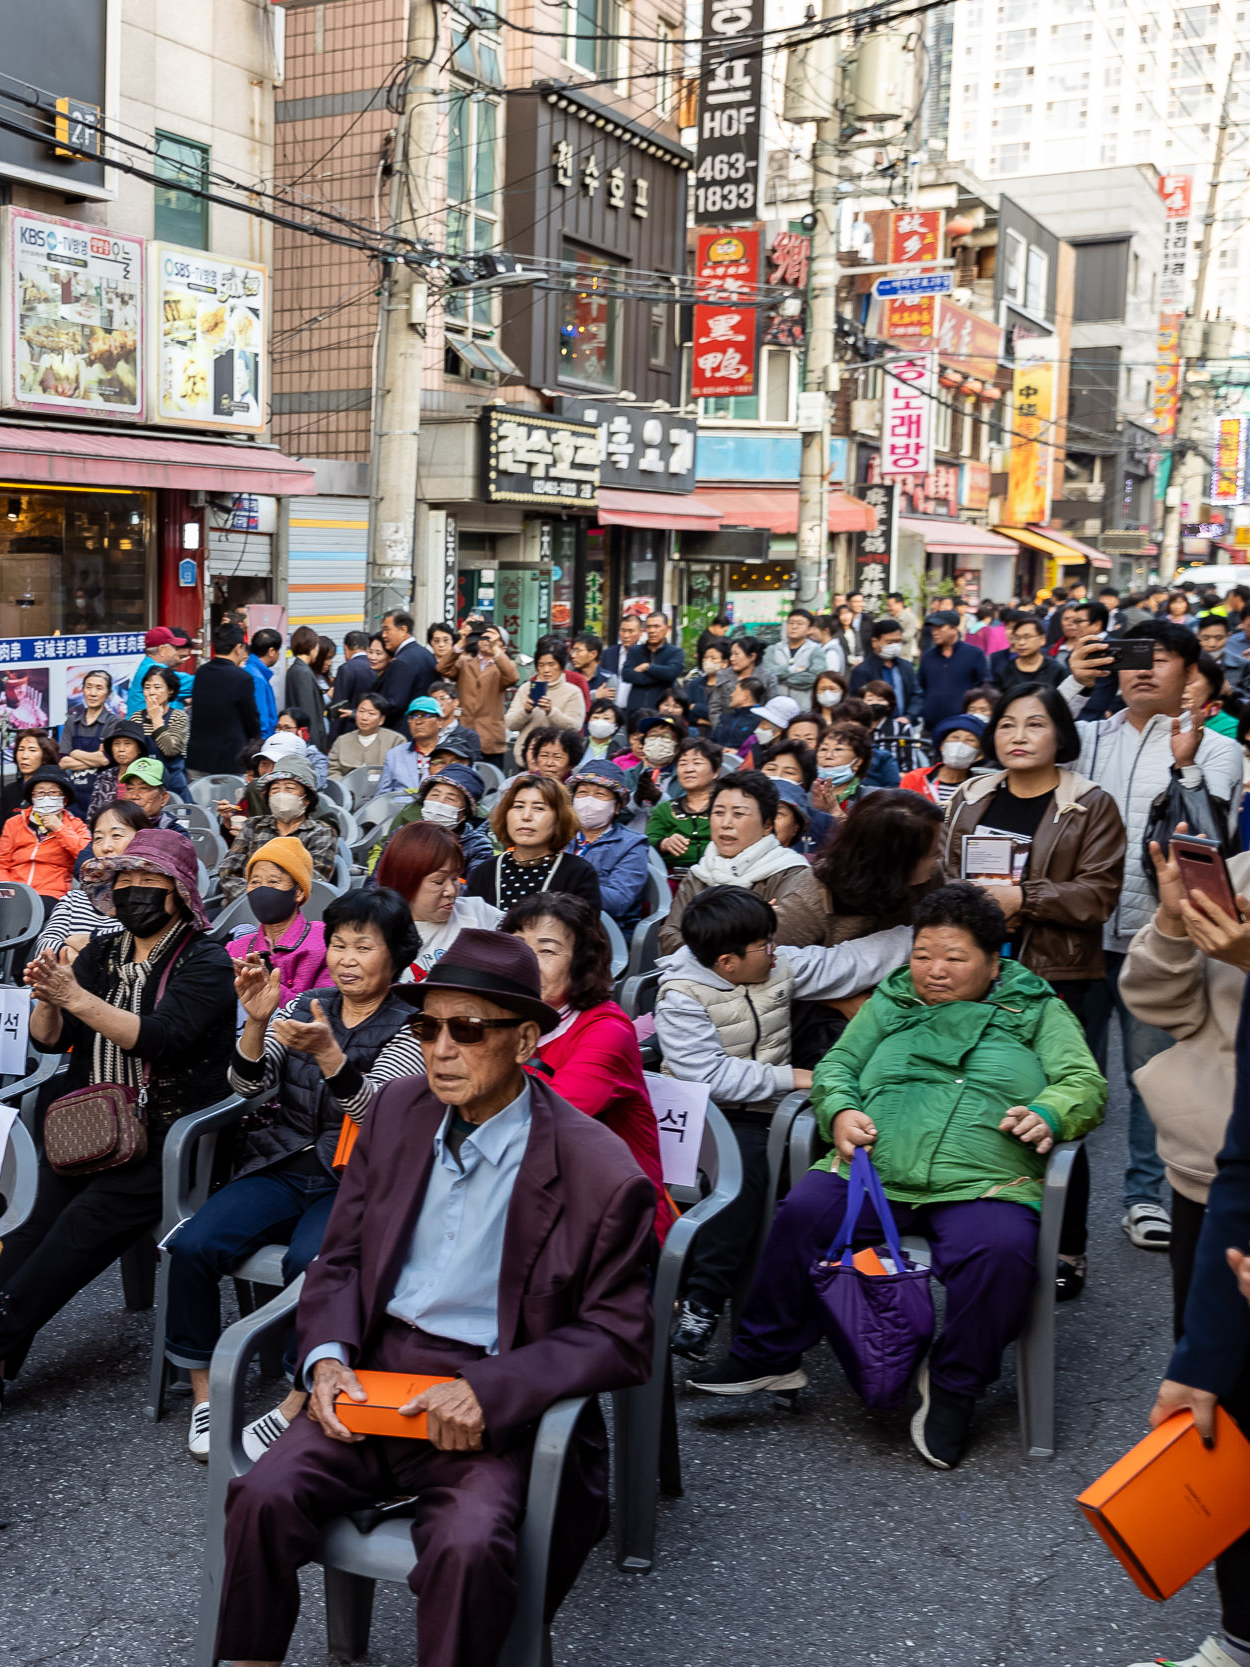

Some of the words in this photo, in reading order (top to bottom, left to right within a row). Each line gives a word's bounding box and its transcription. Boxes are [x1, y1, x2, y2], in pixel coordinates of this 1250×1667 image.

[72, 111, 96, 146] 2F
[702, 106, 756, 139] HOF
[557, 140, 648, 218] 천수호프
[697, 152, 757, 182] 463-
[696, 183, 755, 213] 1833
[20, 226, 45, 247] KBS
[174, 262, 190, 278] SBS
[498, 421, 599, 483] 천수호프
